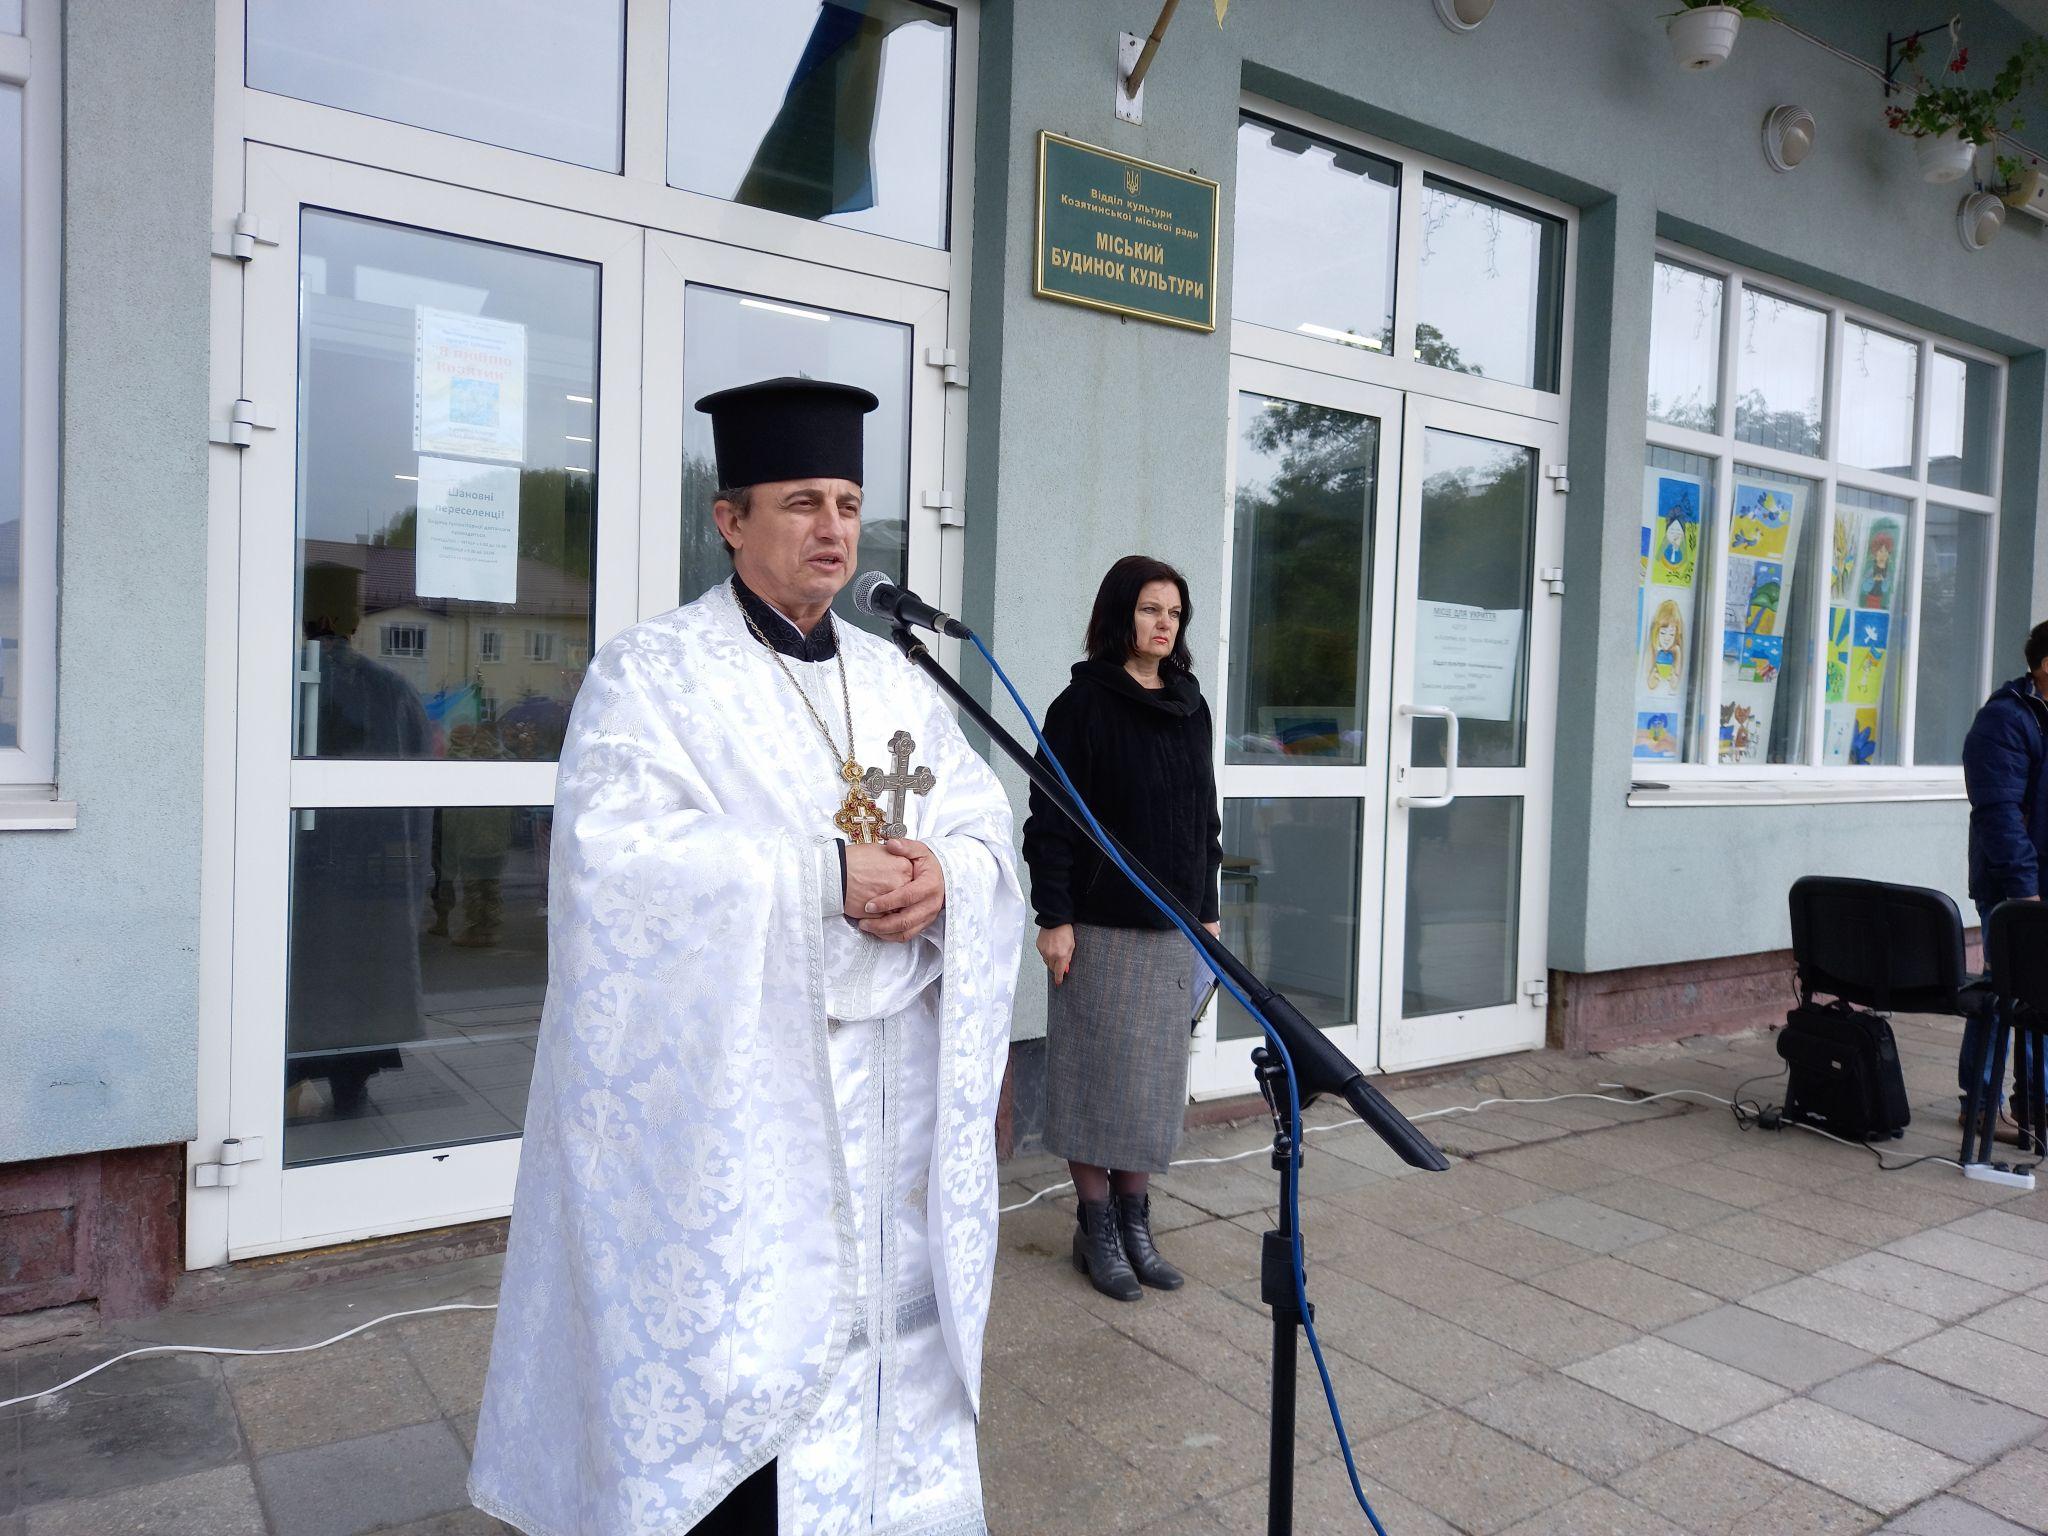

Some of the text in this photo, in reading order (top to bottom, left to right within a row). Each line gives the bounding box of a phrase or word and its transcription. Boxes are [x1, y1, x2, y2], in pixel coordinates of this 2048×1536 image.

[1061, 194, 1199, 240] Козятинської міської ради
[1091, 189, 1172, 219] Відділ культури
[1096, 231, 1164, 265] МІСЬКИЙ
[1051, 247, 1203, 299] БУДИНОК КУЛЬТУРИ
[448, 488, 494, 502] Шановні
[435, 504, 505, 520] переселенці!
